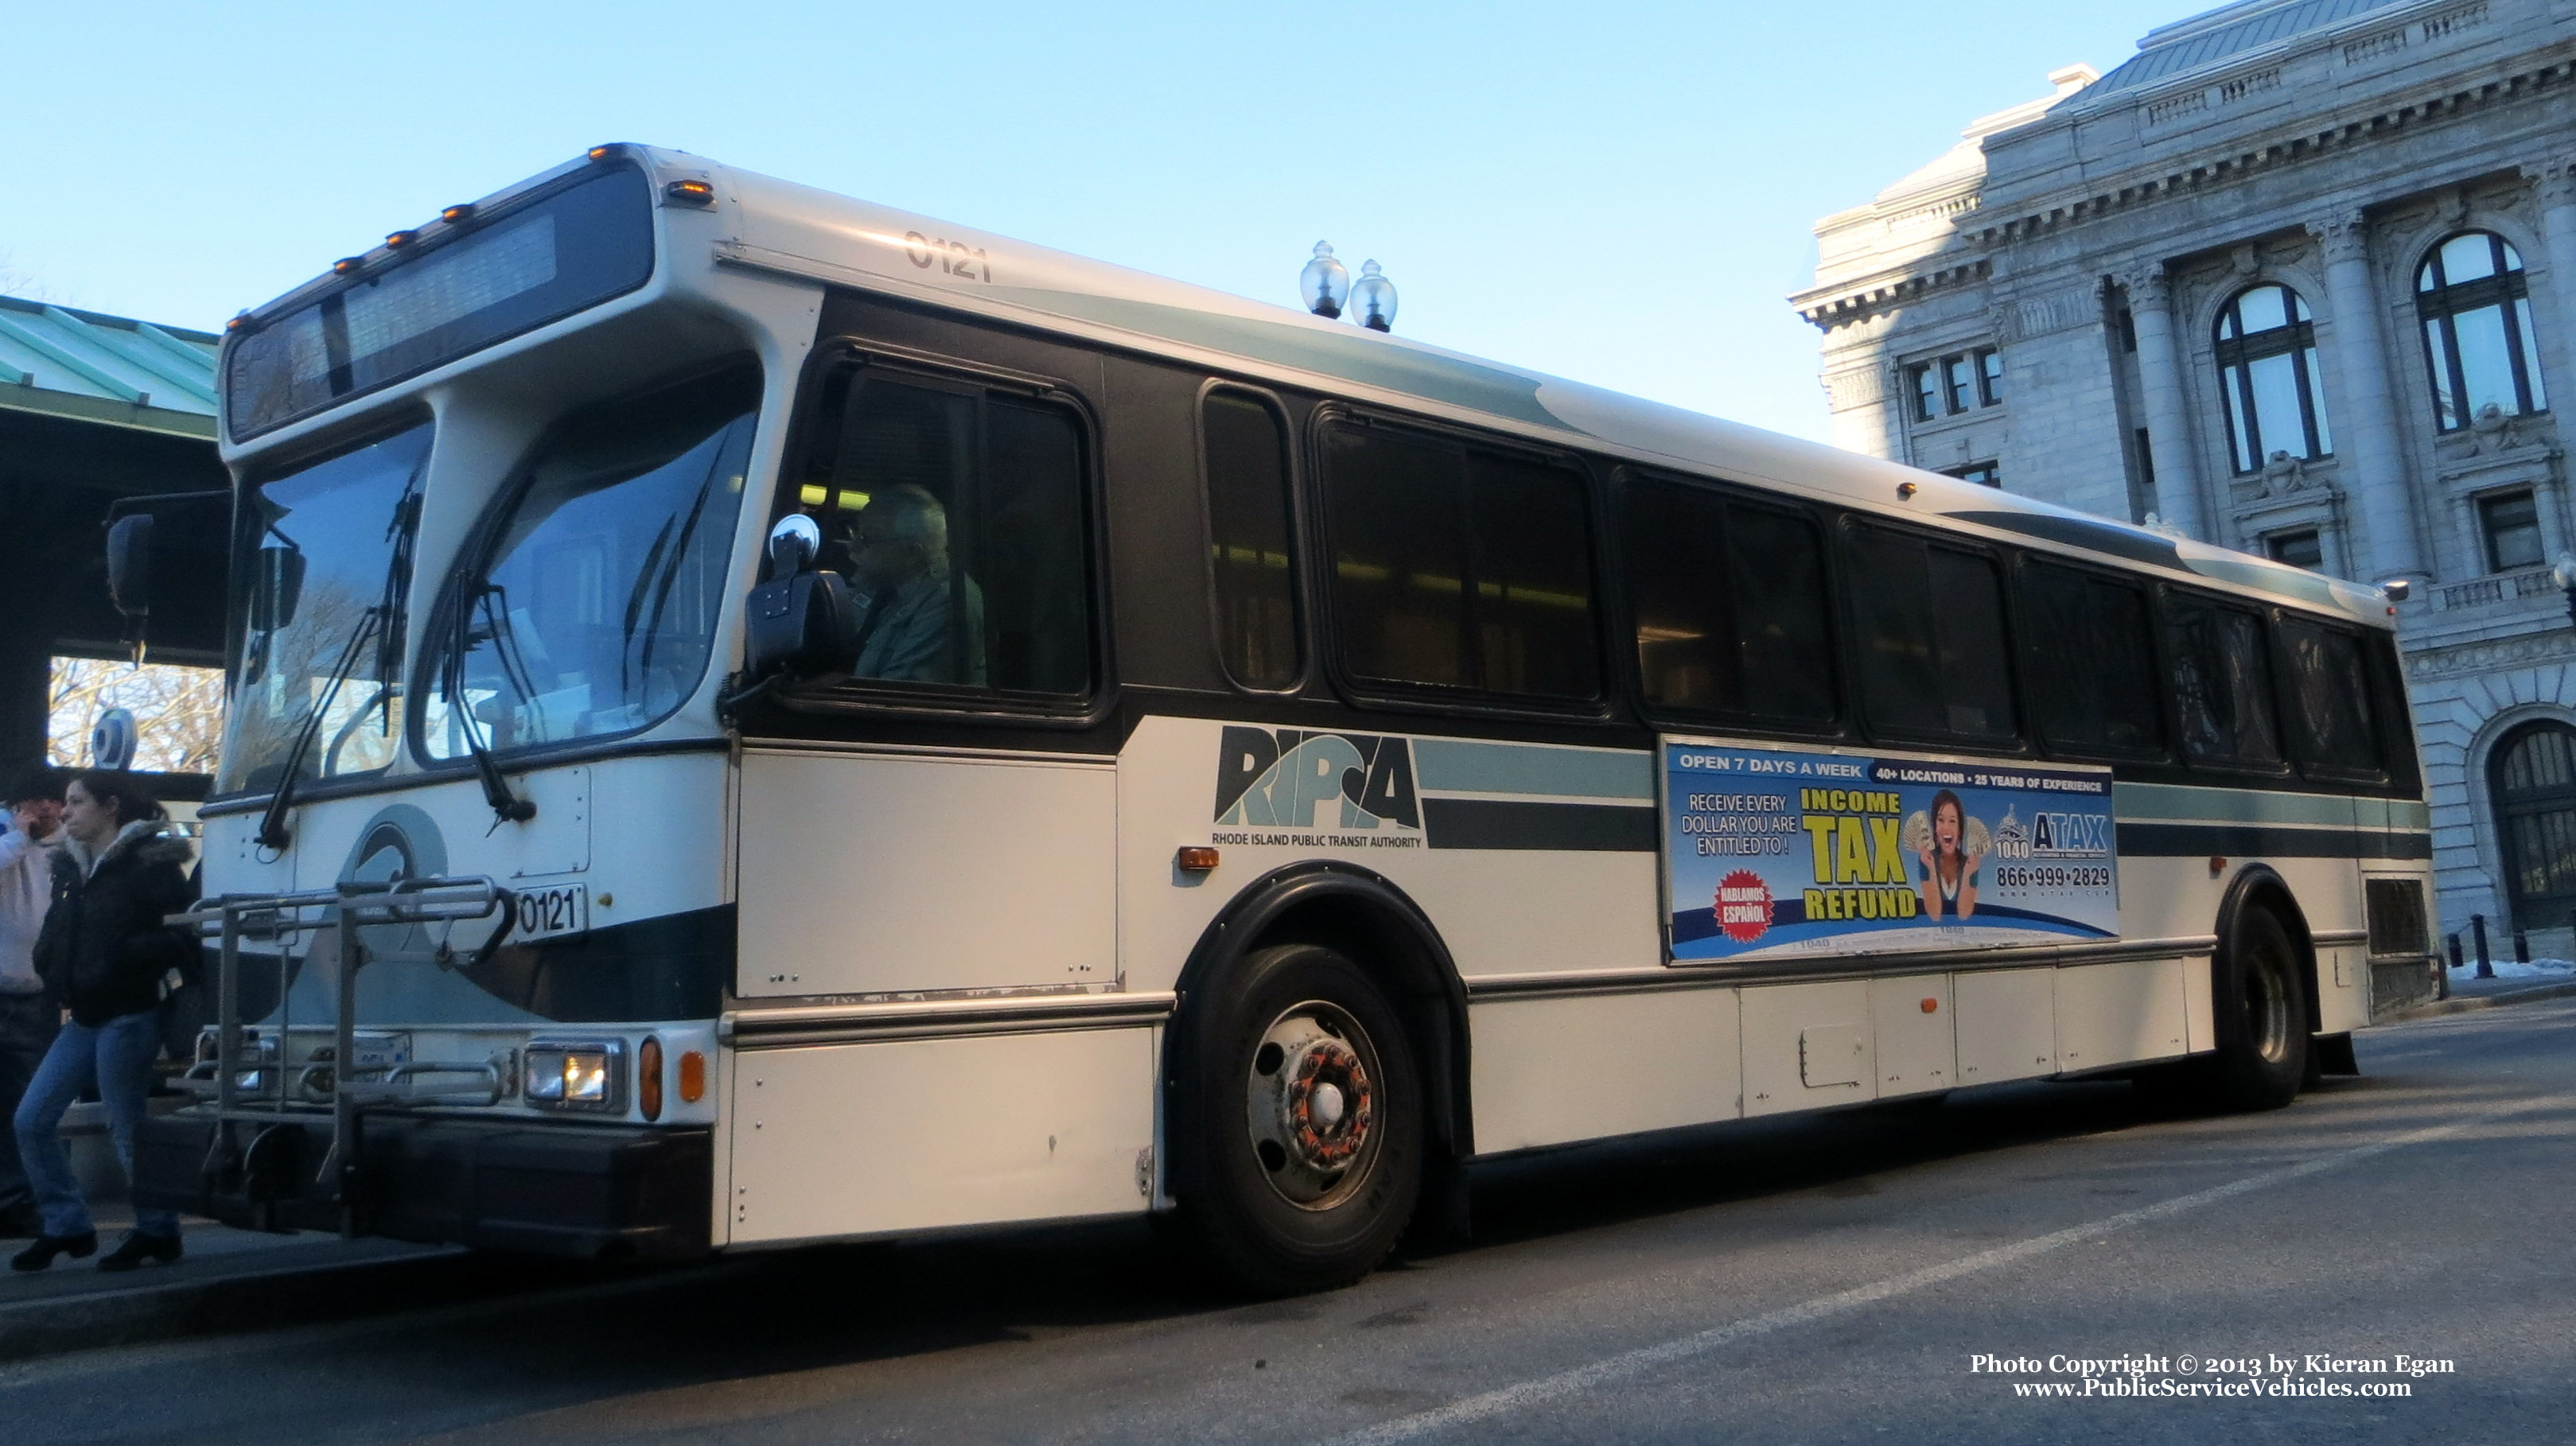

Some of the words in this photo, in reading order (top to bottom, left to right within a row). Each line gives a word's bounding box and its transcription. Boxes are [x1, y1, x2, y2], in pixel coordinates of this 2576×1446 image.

[905, 231, 990, 283] 0121
[1679, 755, 1730, 770] OPEN
[1734, 758, 1745, 771] 7
[1750, 759, 1796, 774] DAYS
[1800, 762, 1812, 775] A
[1815, 763, 1863, 778] WEEK
[1876, 768, 1898, 779] 40+
[1900, 768, 1965, 784] LOCATIONS
[1974, 774, 1988, 786] 25
[1989, 775, 2025, 787] YEARS
[2026, 777, 2041, 788] OF
[2042, 779, 2103, 792] EXPERIENCE
[1689, 794, 1744, 811] RECEIVE
[1746, 795, 1787, 812] EVERY
[1800, 788, 1901, 814] INCOME
[1682, 815, 1737, 834] DOLLAR
[1737, 816, 1768, 834] YOU
[1771, 816, 1796, 834] ARE
[2033, 813, 2107, 851] ATAX
[1212, 833, 1248, 845] RHODE
[1251, 834, 1289, 845] ISLAND
[1291, 834, 1325, 846] PUBLIC
[1328, 836, 1368, 847] TRANSIT
[1370, 837, 1421, 848] AUTHORITY
[1697, 837, 1761, 854] ENTITLED
[1802, 815, 1908, 883] TAX
[1995, 841, 2029, 859] 1040
[1720, 887, 1765, 903] HABLAMOS
[1804, 888, 1916, 920] REFUND
[520, 888, 575, 933] 0121
[1722, 902, 1766, 924] ESPAÑOL
